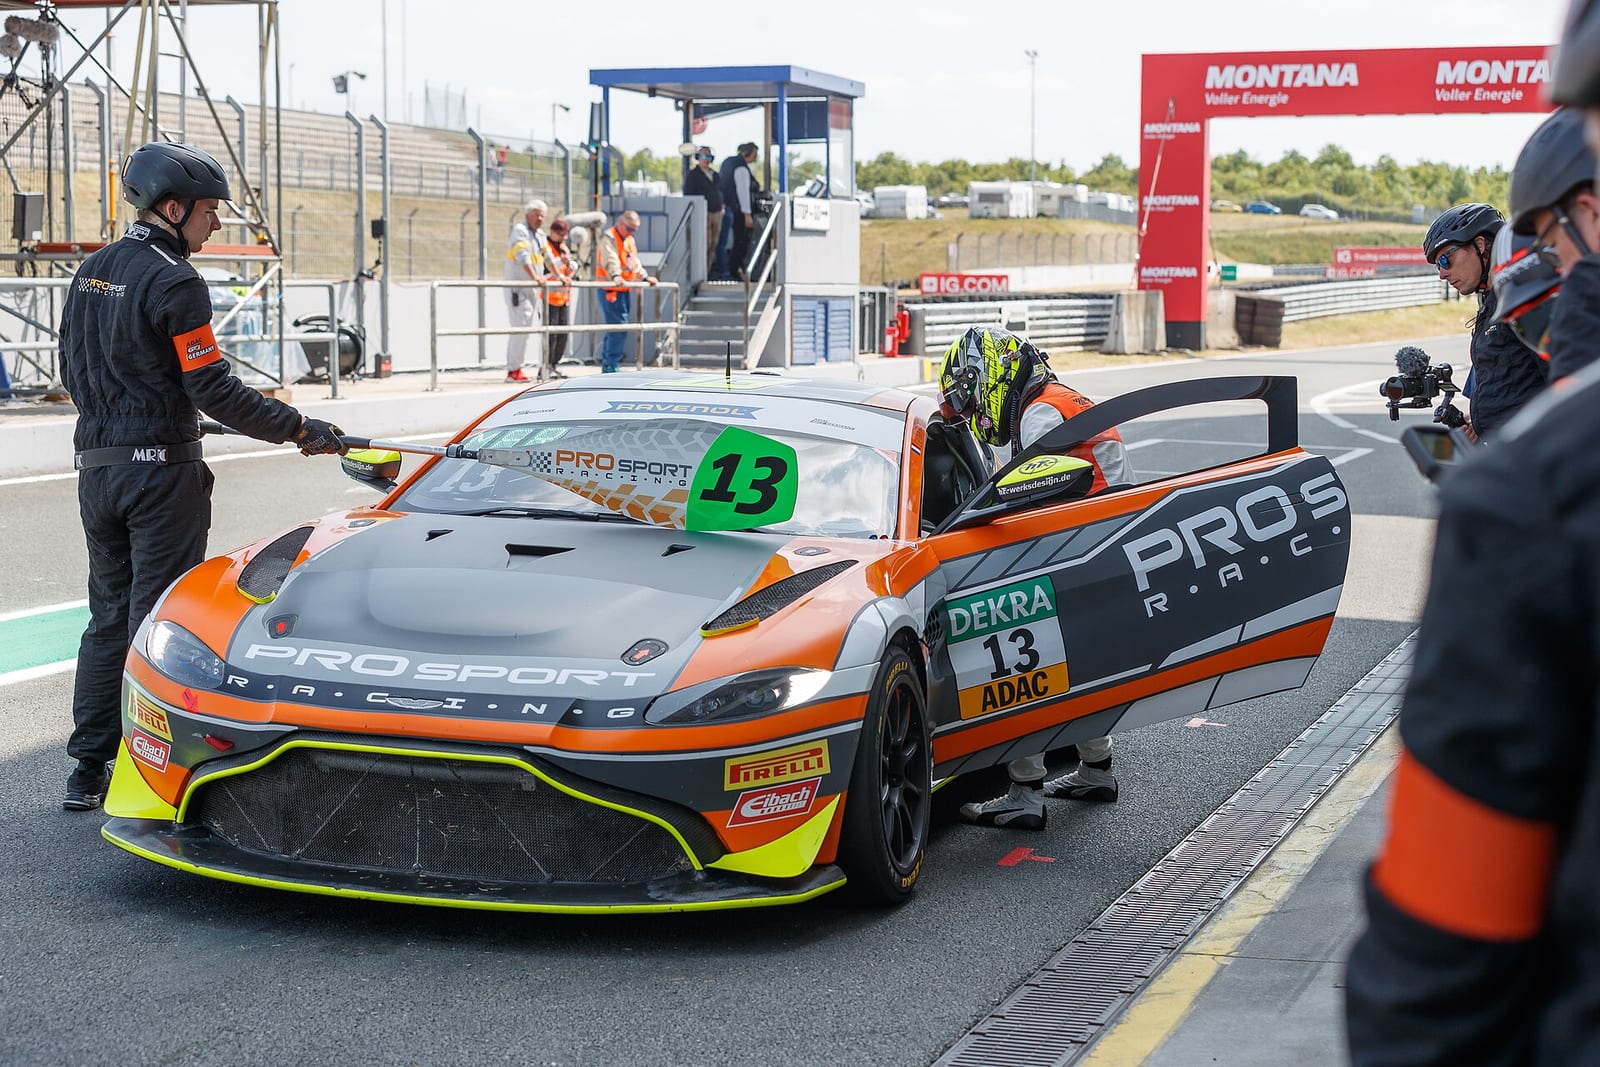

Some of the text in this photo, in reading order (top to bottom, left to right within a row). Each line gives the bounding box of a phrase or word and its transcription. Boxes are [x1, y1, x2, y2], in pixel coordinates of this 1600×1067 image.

[1205, 63, 1359, 89] MONTANA
[1205, 92, 1289, 107] Voller Energie
[1435, 87, 1523, 104] Voller Energie
[1144, 122, 1200, 133] MONTANA
[1143, 195, 1199, 206] MONTANA
[939, 275, 1007, 294] IG.COM
[1141, 266, 1197, 277] MONTANA
[616, 403, 745, 416] RAVENOL
[556, 450, 692, 478] PRO SPORT
[700, 453, 788, 515] 13
[948, 584, 1053, 637] DEKRA
[983, 628, 1040, 680] 13
[413, 663, 656, 687] SPORT
[982, 671, 1049, 712] ADAC
[129, 692, 168, 734] PRELLI
[132, 736, 165, 764] Eibach
[729, 747, 823, 785] PIRELLI
[740, 786, 811, 818] Eibach
